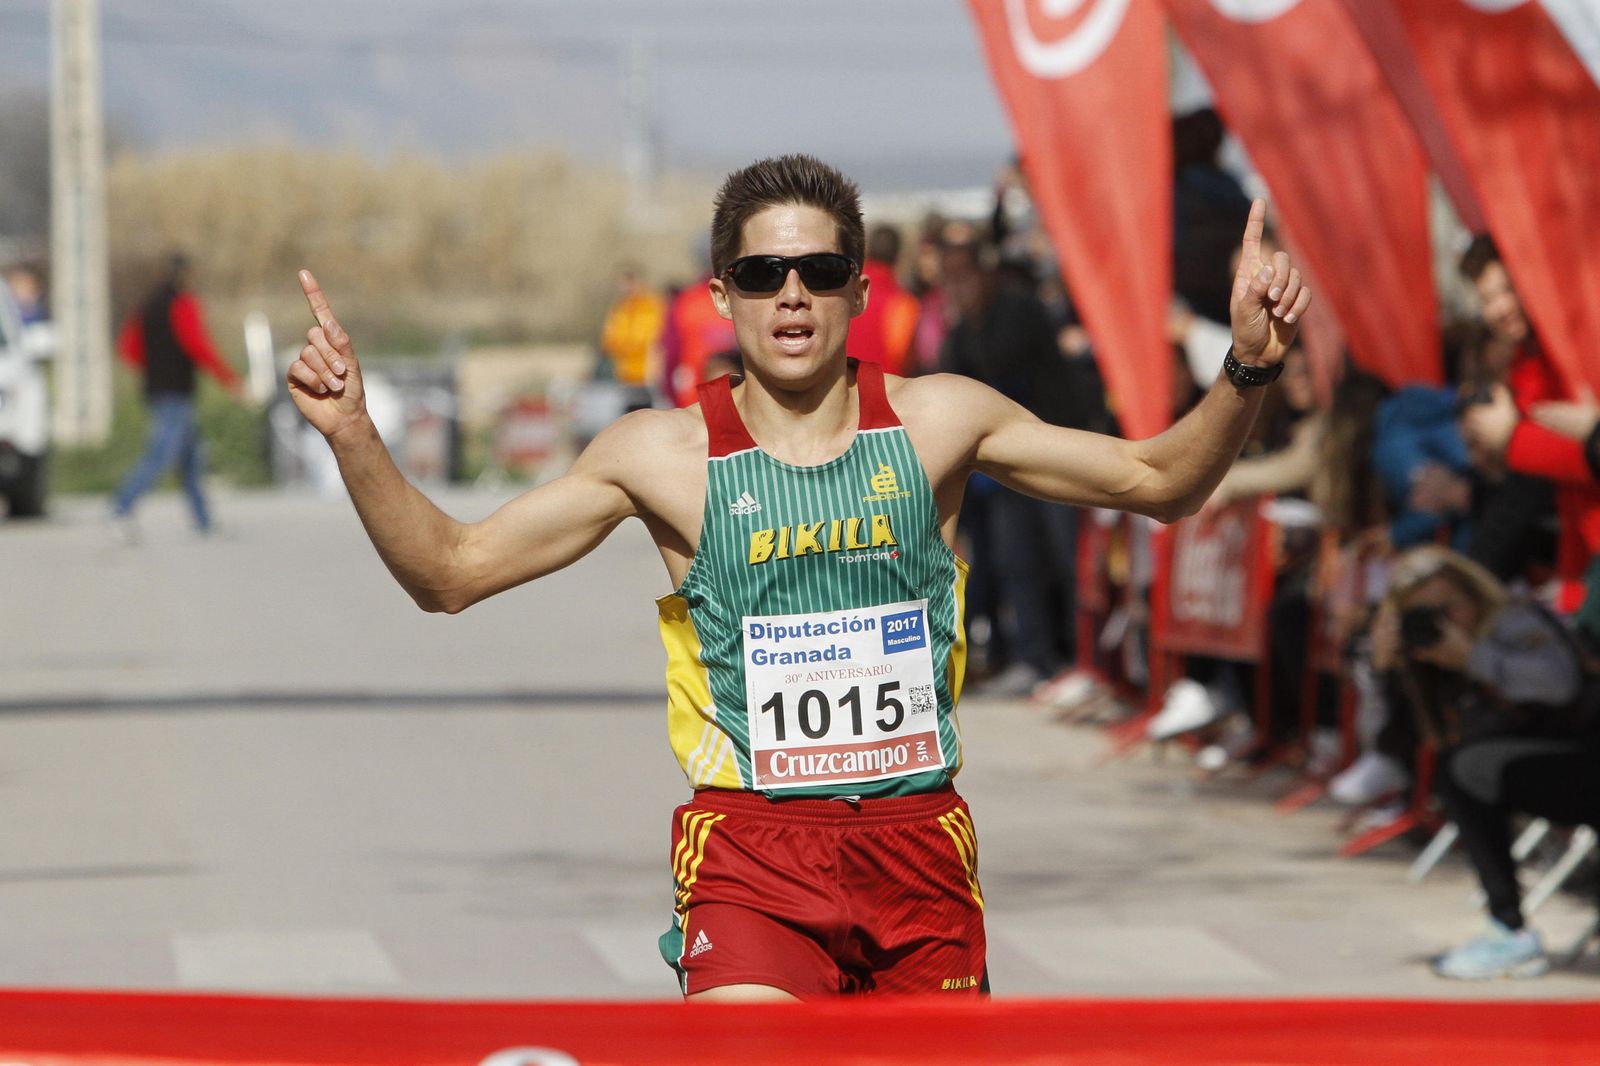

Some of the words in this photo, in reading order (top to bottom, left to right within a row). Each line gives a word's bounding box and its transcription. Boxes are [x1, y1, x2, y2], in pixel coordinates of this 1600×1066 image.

[729, 502, 762, 515] adidas
[748, 514, 900, 566] BIKILA
[749, 616, 876, 642] Diputación
[887, 616, 918, 634] 2017
[887, 634, 921, 646] Masculino
[751, 645, 852, 666] Granada
[806, 663, 893, 683] ANIVERSARIO
[761, 681, 905, 742] 1015
[769, 744, 907, 778] Cruzcampo
[916, 741, 929, 762] SIN
[689, 942, 713, 958] adidas
[941, 975, 978, 990] BIKILA
